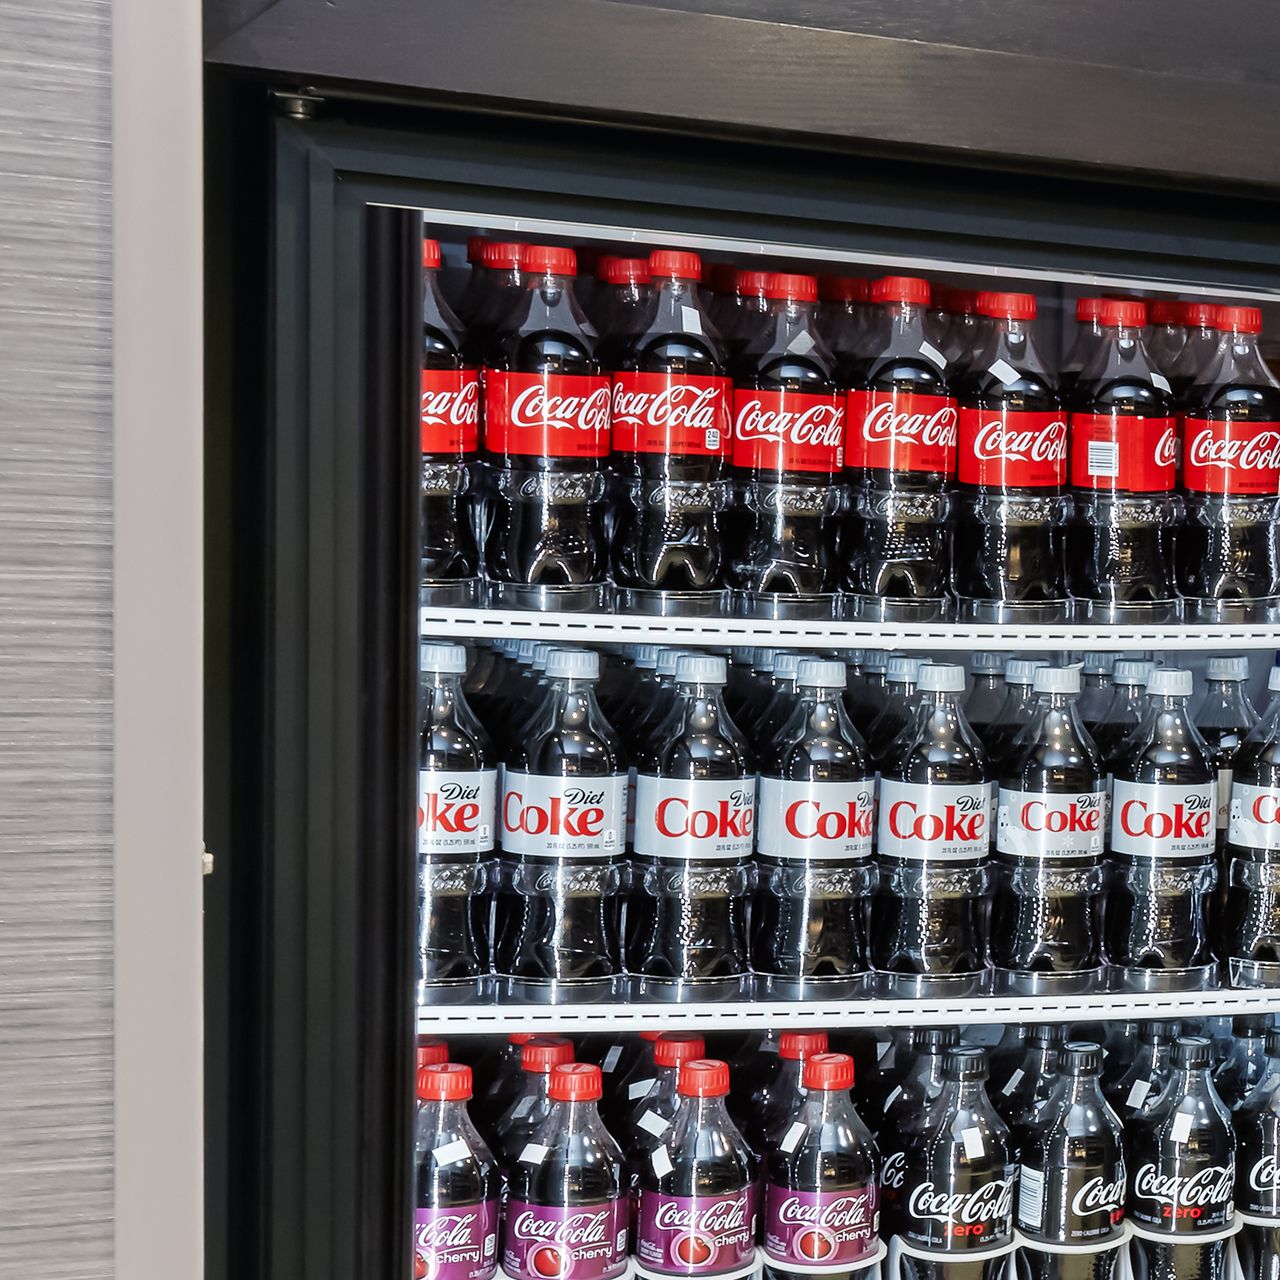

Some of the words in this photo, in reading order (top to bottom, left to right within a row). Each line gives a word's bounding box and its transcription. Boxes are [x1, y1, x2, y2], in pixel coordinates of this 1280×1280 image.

[511, 383, 611, 430] Coca-Col
[612, 383, 720, 429] Coca-Cola
[735, 399, 844, 447] Coca-Cola
[862, 401, 957, 448] Coca-Col
[973, 420, 1067, 462] Coca-Col
[440, 782, 480, 800] Diet
[563, 787, 604, 805] Diet
[419, 792, 480, 832] ke
[503, 791, 605, 836] Coke
[655, 797, 753, 839] Coke
[889, 801, 985, 841] Coke
[1021, 801, 1100, 833] Coke
[1121, 799, 1210, 839] Coke
[1134, 1163, 1235, 1206] Coca-Cola
[514, 1211, 610, 1245] Coca-Cola
[655, 1196, 747, 1233] Coca-Cola
[779, 1194, 868, 1229] Coca-Cola
[1162, 1207, 1203, 1218] zero
[714, 1230, 749, 1247] cherry
[835, 1224, 871, 1242] cherry
[434, 1249, 479, 1264] cherry
[571, 1246, 612, 1262] cherry
